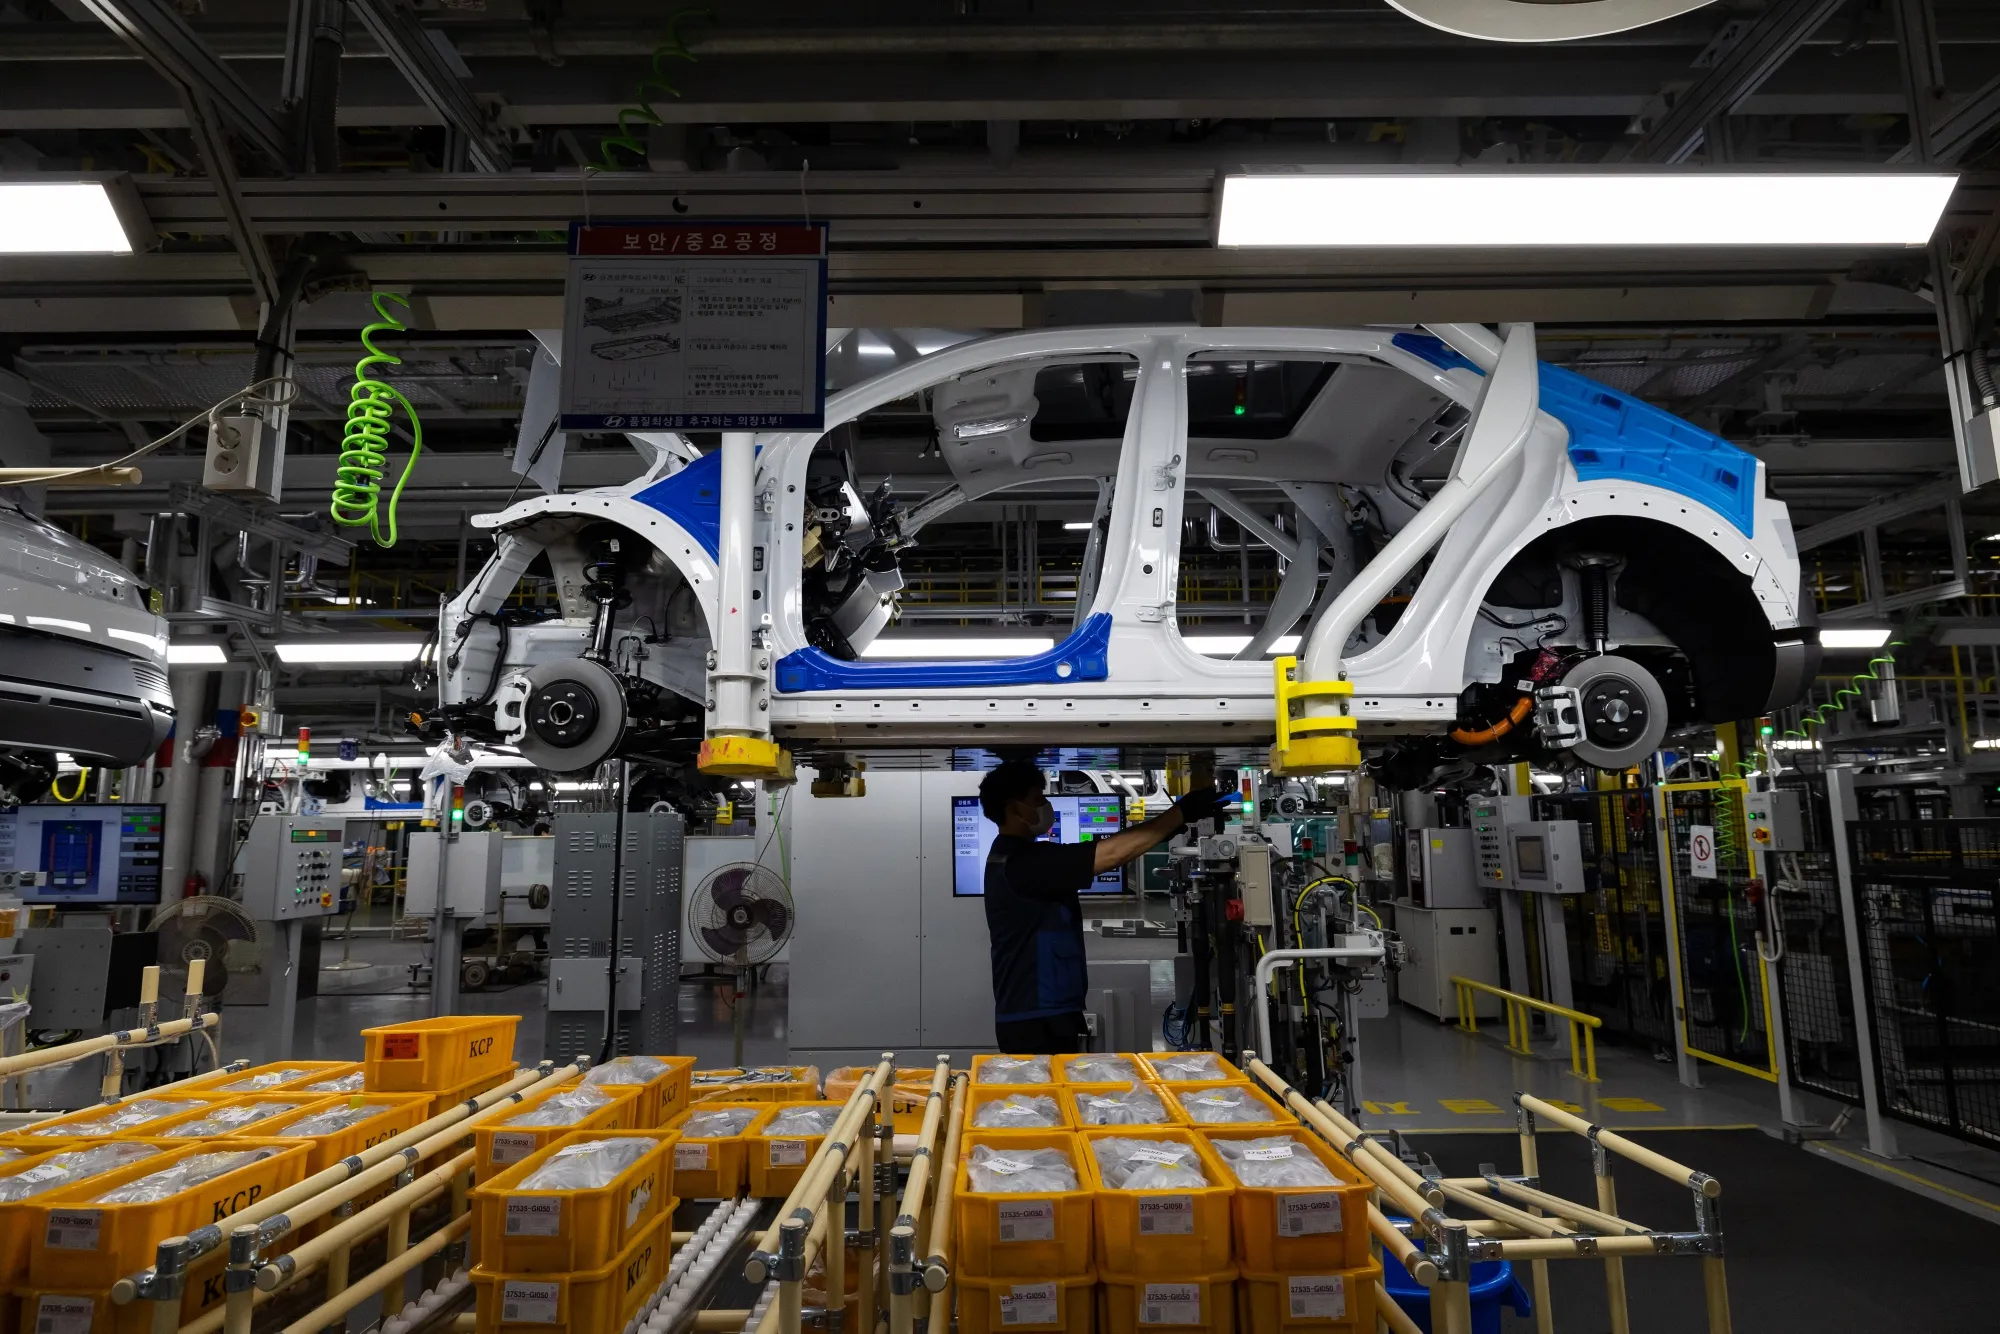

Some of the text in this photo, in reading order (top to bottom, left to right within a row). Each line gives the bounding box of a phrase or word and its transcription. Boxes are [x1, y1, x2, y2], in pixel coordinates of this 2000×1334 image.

[622, 232, 777, 252] 보안/중요공정
[674, 275, 686, 284] NE
[629, 416, 783, 427] 품질최상을 추구하는 의장1부!
[469, 1036, 494, 1058] KCP
[662, 1081, 678, 1108] KCP
[211, 1183, 262, 1223] KCP
[1140, 1203, 1184, 1211] 37535-GI050
[1287, 1202, 1331, 1212] 37535-GI050
[507, 1205, 552, 1213] 37535-GI050
[1000, 1210, 1044, 1219] 37535-GI050
[627, 1246, 652, 1292] KCP
[1290, 1285, 1334, 1293] 37535-GI050
[506, 1290, 550, 1299] 37535-GI050
[1147, 1293, 1191, 1301] 37535-GI050
